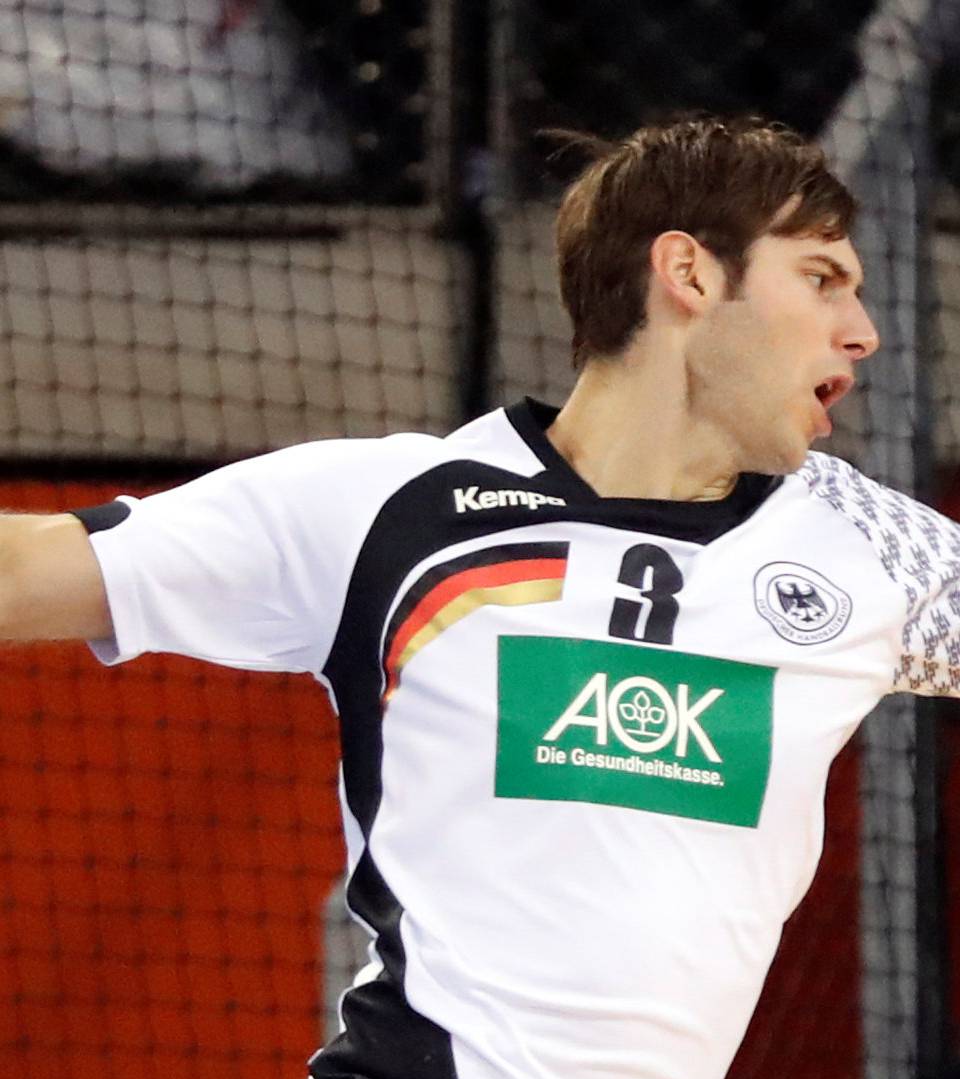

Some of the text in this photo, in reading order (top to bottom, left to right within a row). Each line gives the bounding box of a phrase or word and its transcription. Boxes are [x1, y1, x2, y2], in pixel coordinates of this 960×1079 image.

[453, 486, 567, 513] Kempa
[608, 542, 684, 646] 3
[543, 672, 725, 763] AOK
[535, 744, 725, 788] Die Gesundheitskasse.
